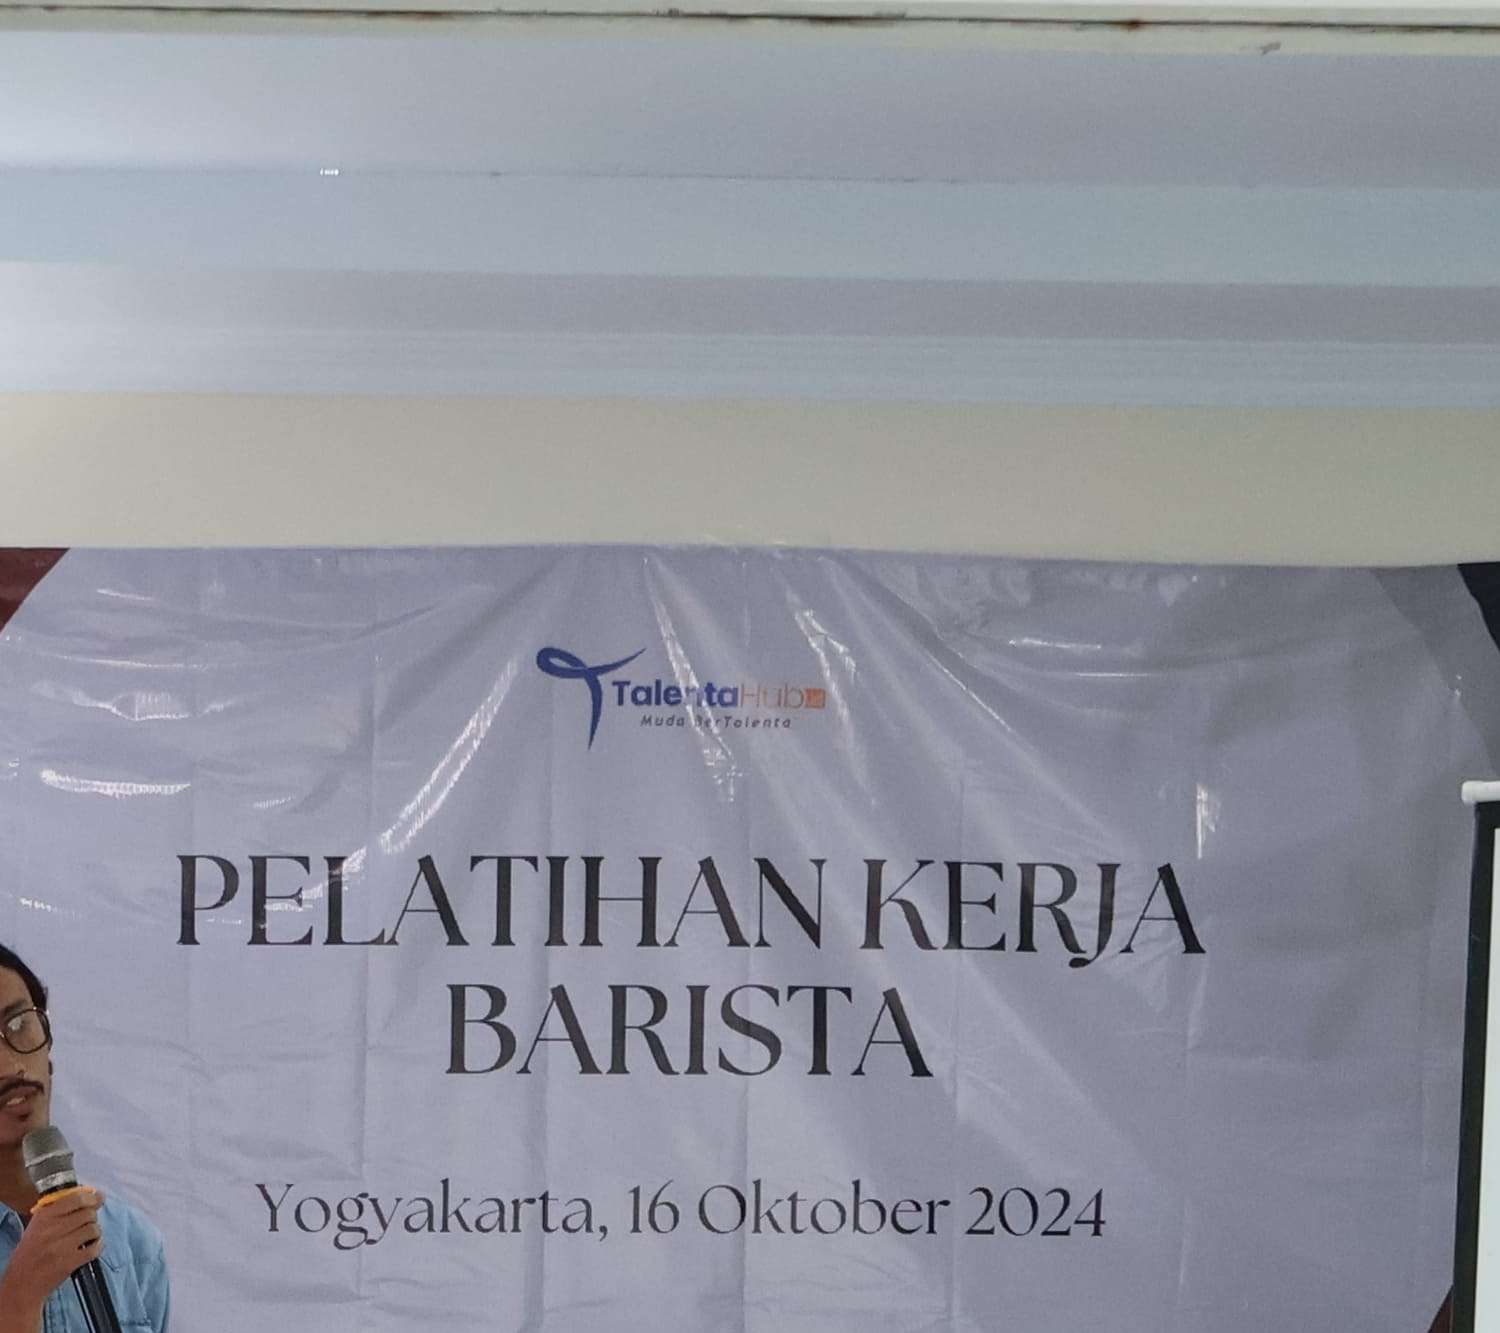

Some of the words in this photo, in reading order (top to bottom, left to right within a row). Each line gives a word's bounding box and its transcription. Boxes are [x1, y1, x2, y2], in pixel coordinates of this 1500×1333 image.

[640, 714, 685, 728] Muda
[176, 854, 829, 948] PELATIHAN
[859, 859, 1206, 968] KERJA
[445, 983, 934, 1077] BARISTA
[255, 1178, 608, 1250] Yogyakarta,
[629, 1179, 680, 1234] 16
[698, 1178, 950, 1235] Oktober
[965, 1186, 1106, 1237] 2024
